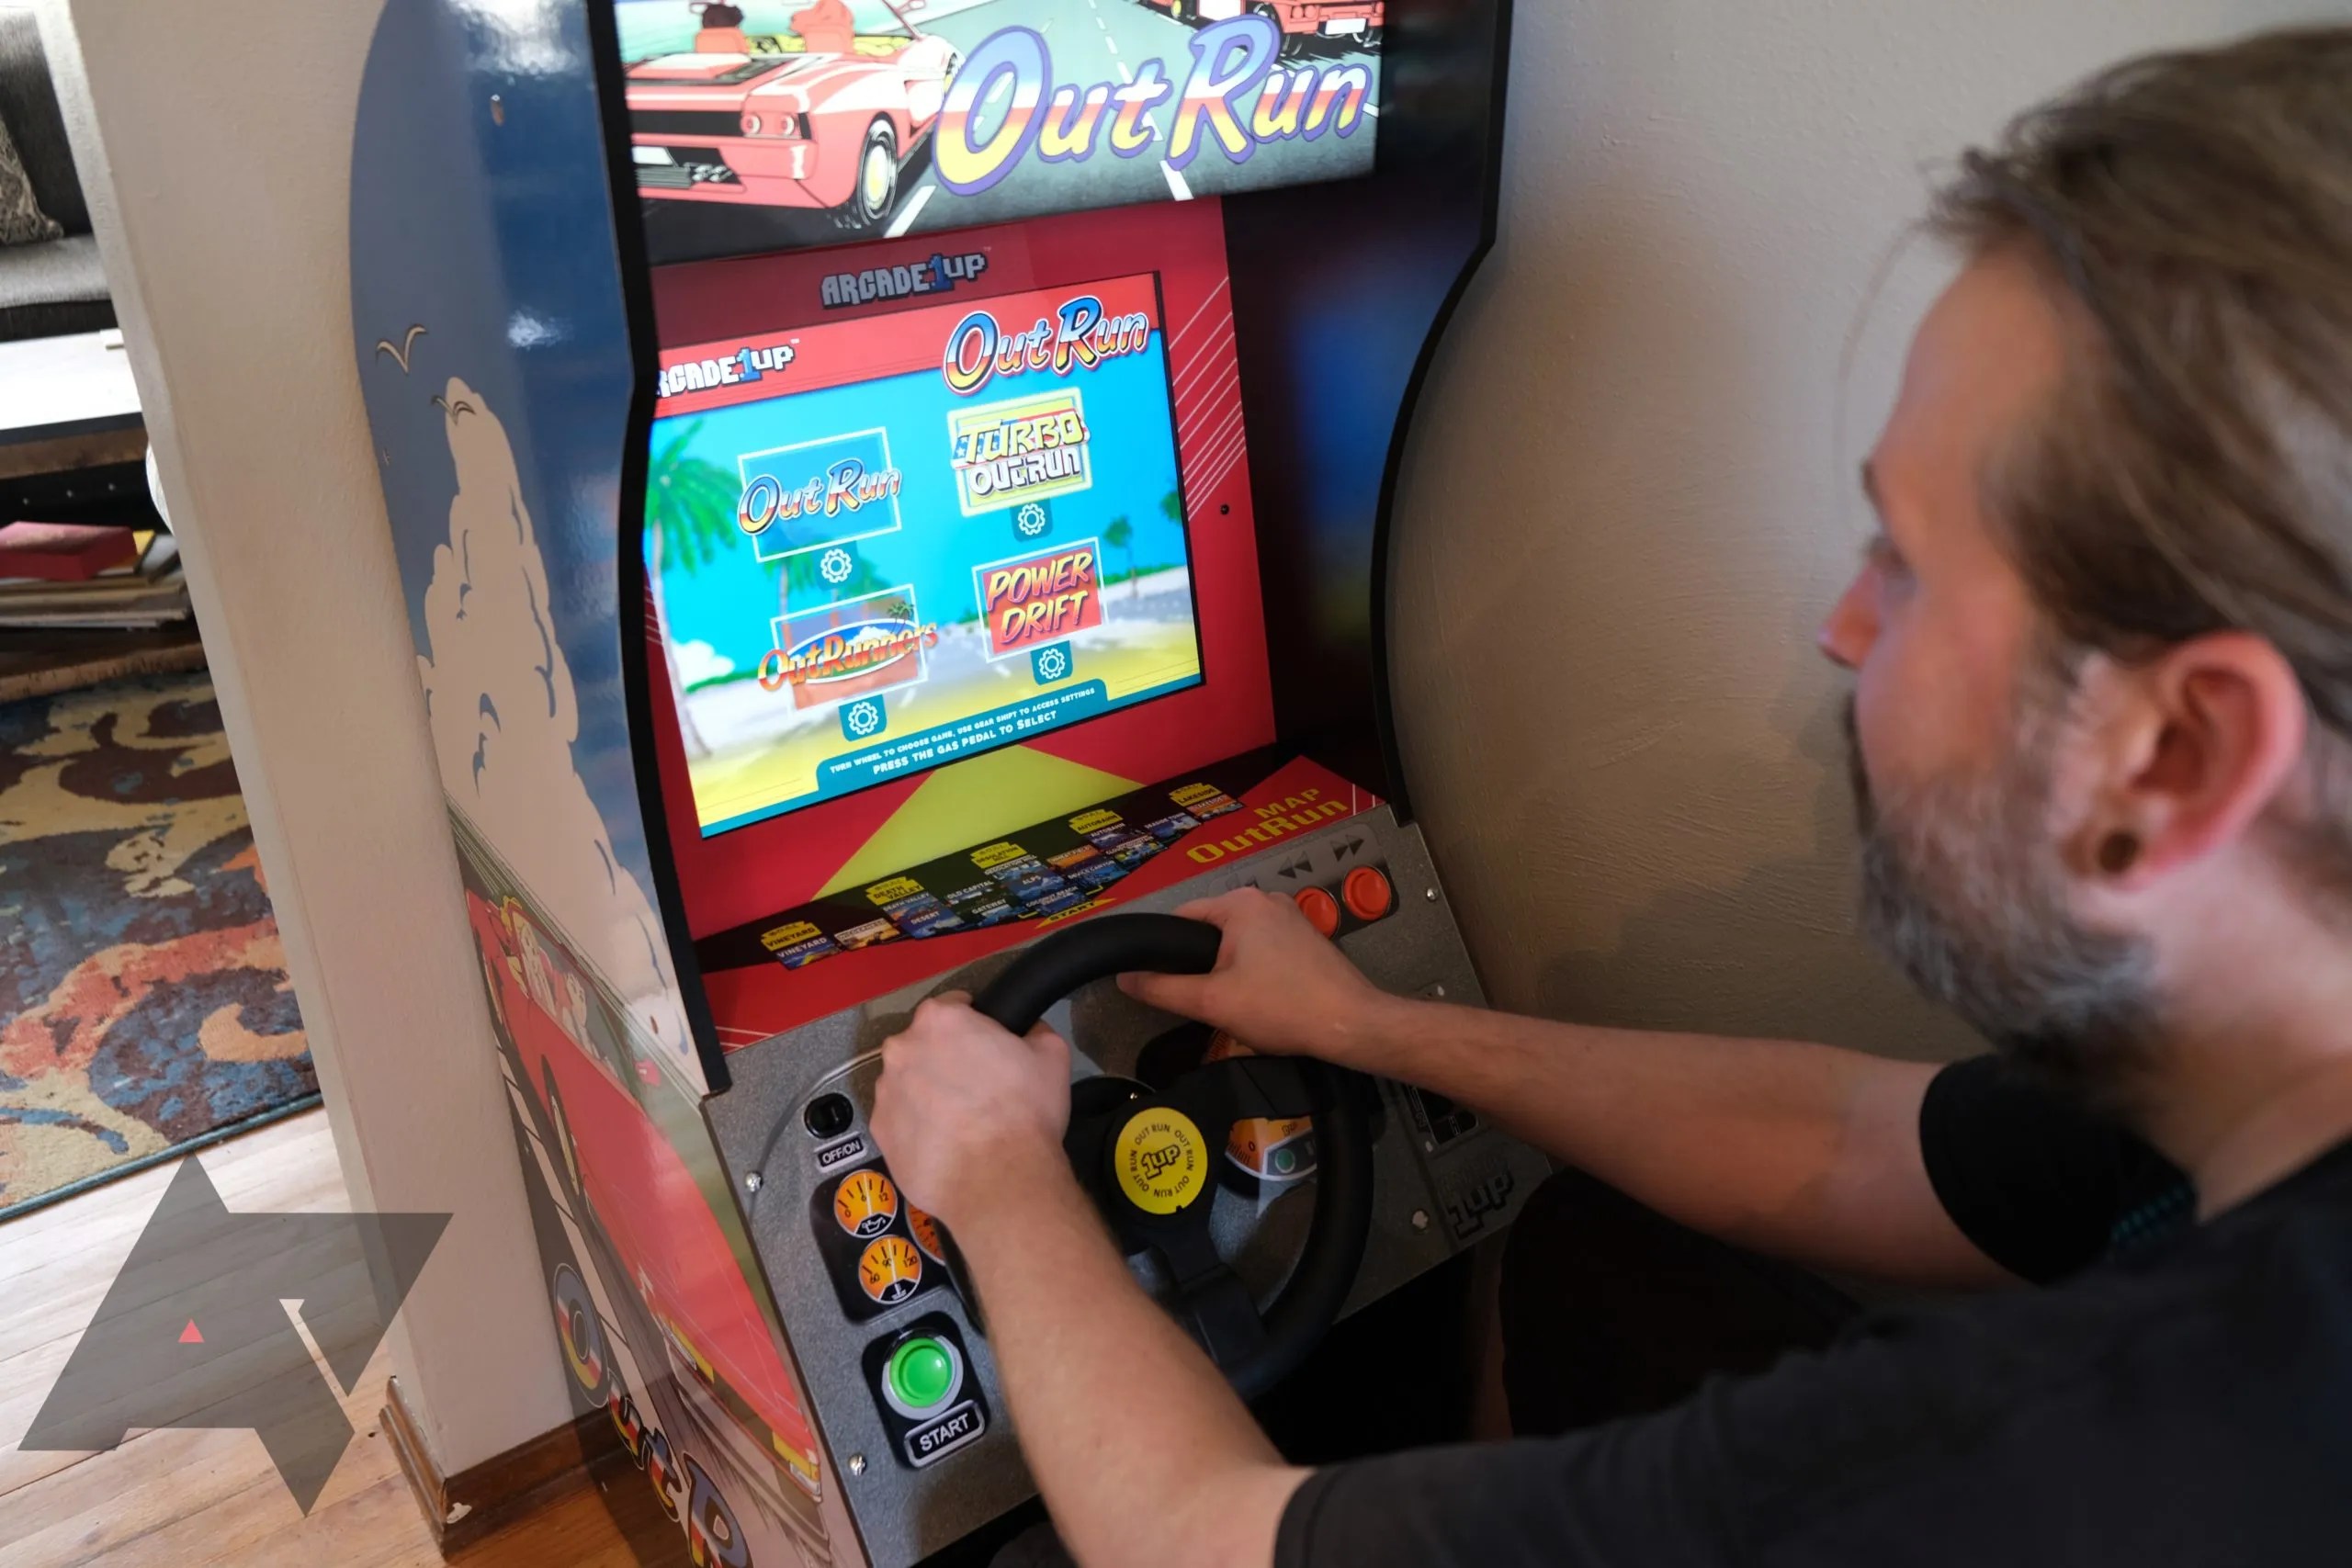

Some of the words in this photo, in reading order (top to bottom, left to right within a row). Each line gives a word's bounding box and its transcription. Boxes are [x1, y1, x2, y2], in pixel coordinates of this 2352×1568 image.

[957, 412, 1084, 463] TURBO
[986, 548, 1092, 612] POWER
[1000, 588, 1089, 645] DRIFT
[757, 620, 939, 692] OutRunners
[830, 762, 852, 773] TURN
[854, 753, 882, 767] WHEEL
[884, 749, 896, 757] TO
[897, 738, 930, 754] CHOOSE
[957, 725, 974, 734] USE
[974, 717, 995, 730] GEAR
[996, 711, 1017, 724] SHIFT
[1019, 706, 1031, 716] TO
[1032, 698, 1059, 713] ACCESS
[1060, 687, 1096, 705] SETTINGS
[873, 757, 909, 775] PRESS
[911, 748, 933, 762] THE
[937, 740, 959, 755] GAS
[961, 730, 996, 748] PEDAL
[999, 723, 1013, 736] TO
[1254, 788, 1319, 818] MAP
[1186, 800, 1348, 863] OutRun
[874, 886, 904, 899] DEATH
[1050, 901, 1096, 921] START
[766, 926, 816, 948] VINEYARD
[778, 937, 828, 959] VINEYARD
[1135, 1126, 1150, 1145] OUT
[1151, 1123, 1170, 1133] RUN
[822, 1142, 861, 1165] OFF/ON
[1128, 1149, 1138, 1172] RUN
[1174, 1130, 1191, 1147] OUT
[1186, 1149, 1194, 1171] RUN
[878, 1192, 889, 1202] 12
[844, 1208, 851, 1218] 0
[903, 1255, 918, 1268] 120
[869, 1273, 881, 1284] 60
[919, 1413, 969, 1451] START
